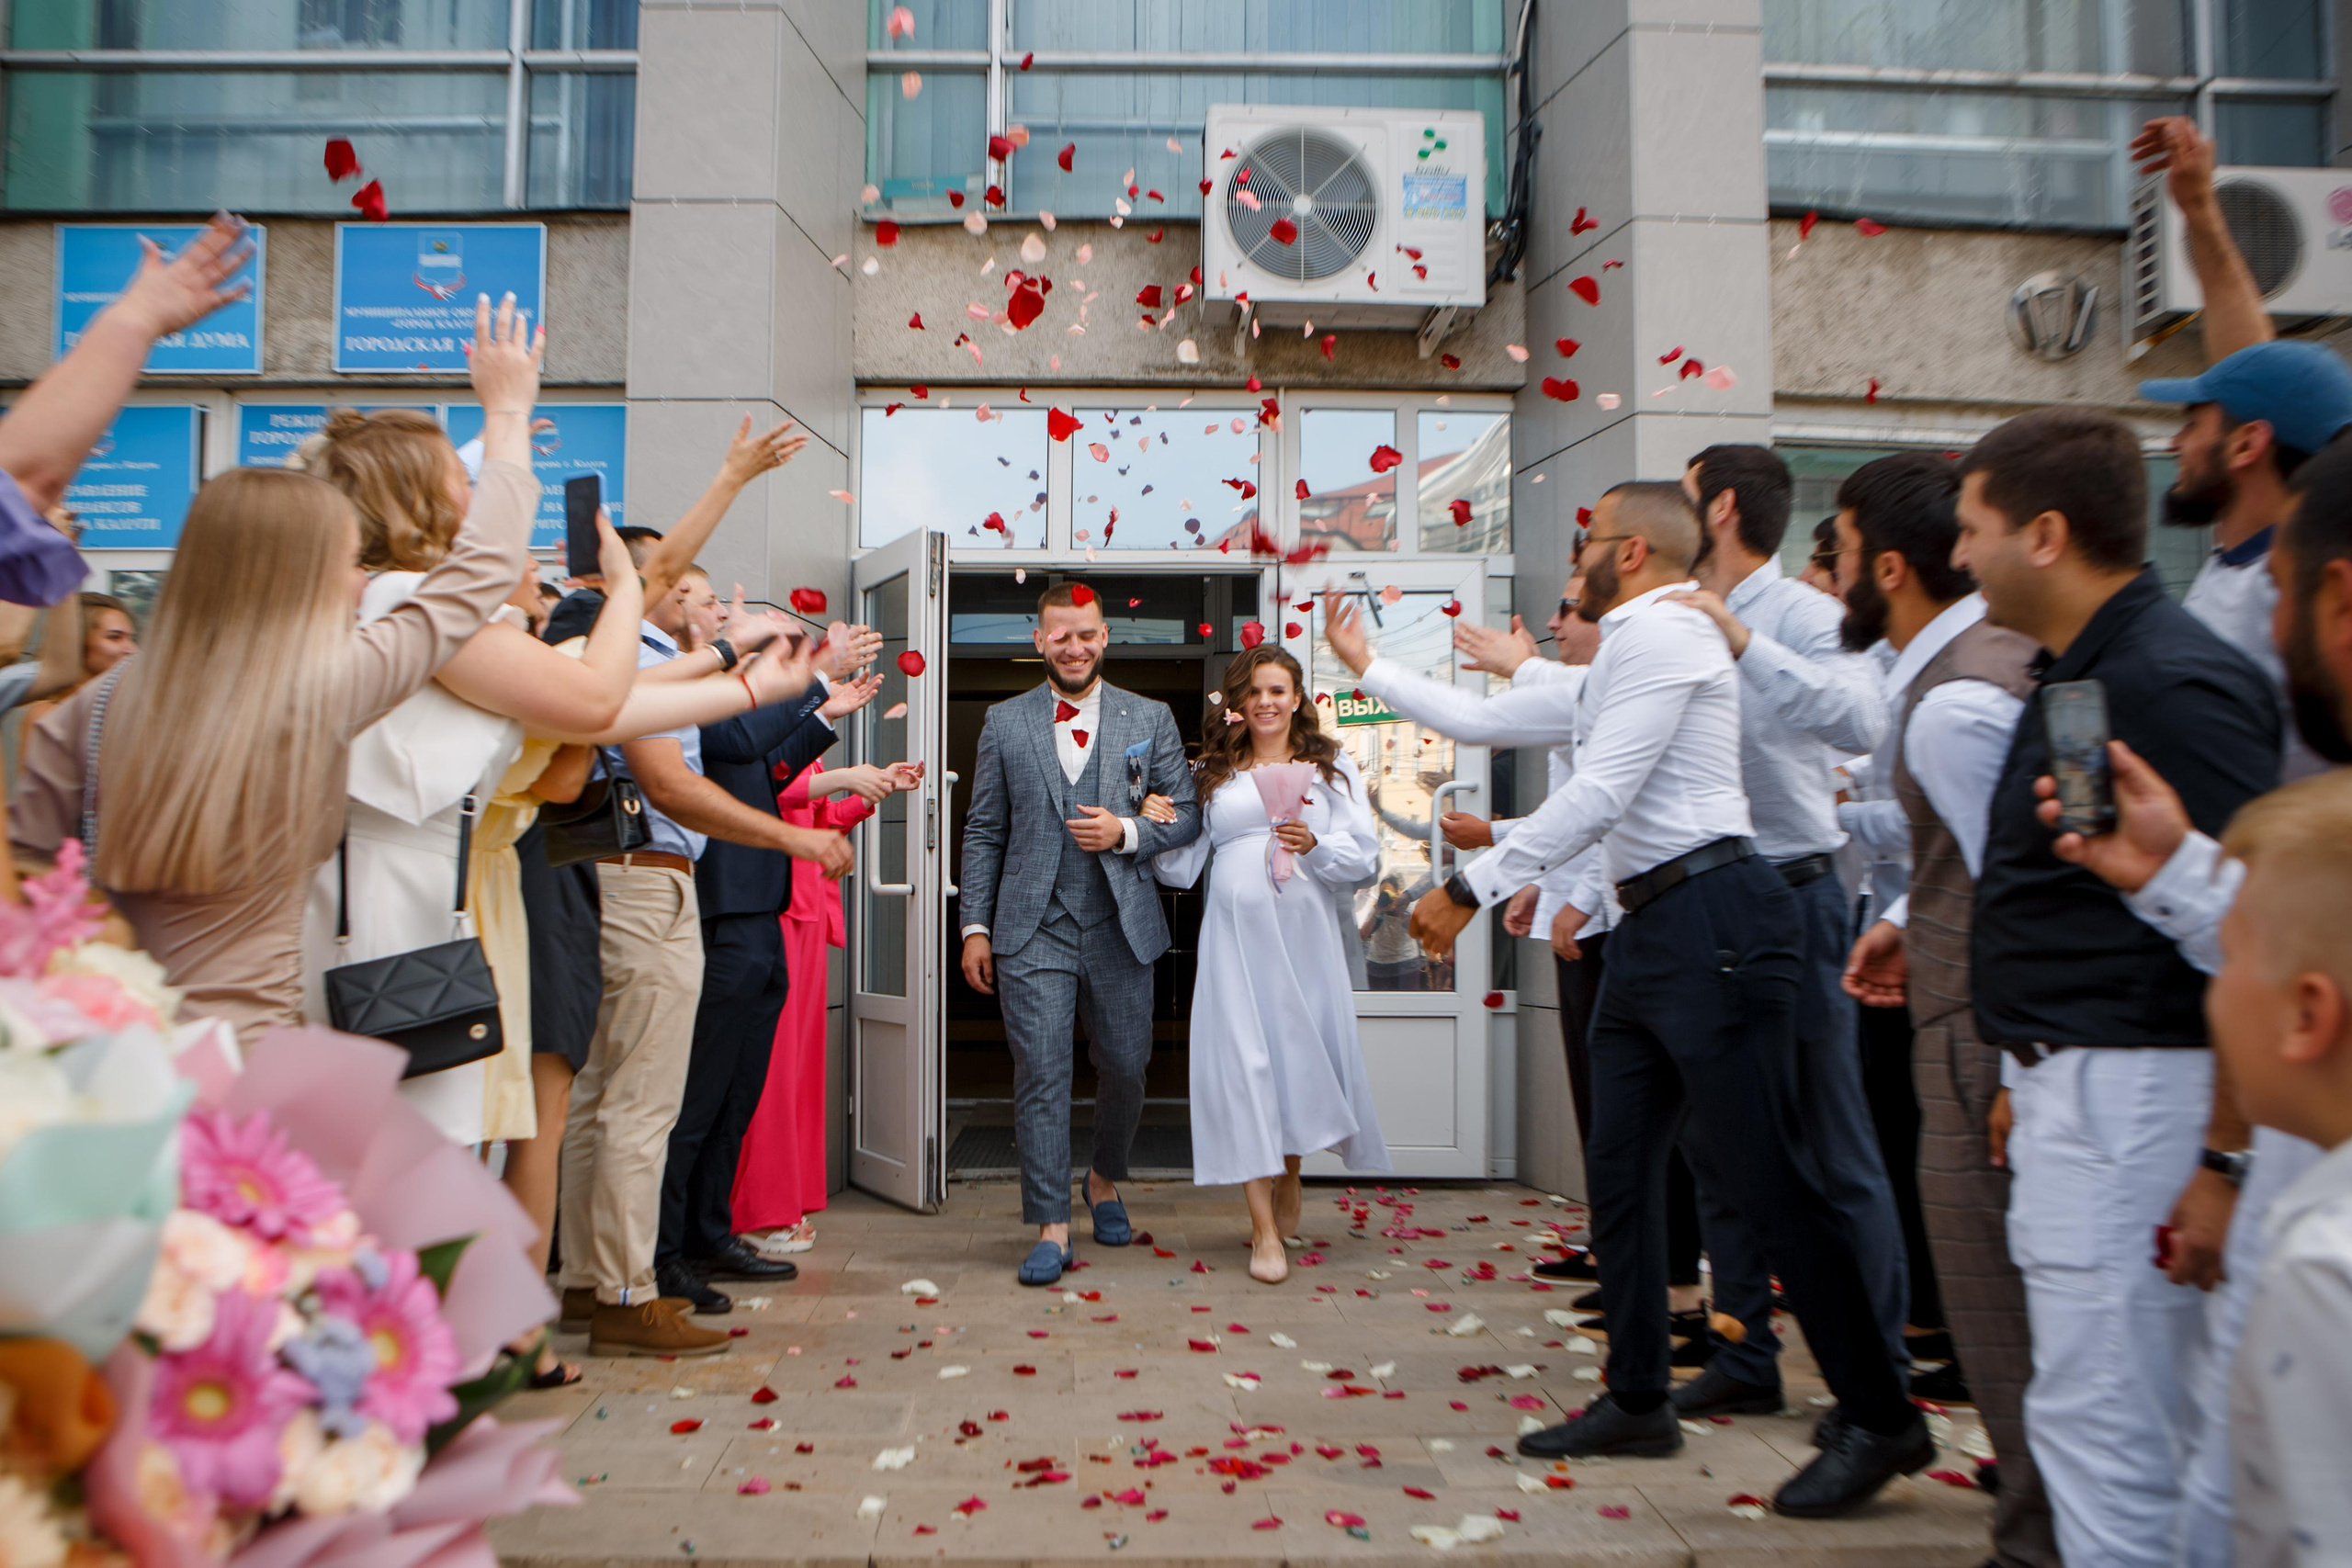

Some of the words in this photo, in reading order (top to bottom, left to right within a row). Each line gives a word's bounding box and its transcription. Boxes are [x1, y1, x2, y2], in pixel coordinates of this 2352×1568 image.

[187, 332, 251, 348] ДУМА
[345, 336, 455, 352] ГОРОДСКАЯ
[1338, 696, 1397, 717] ВЫХ
